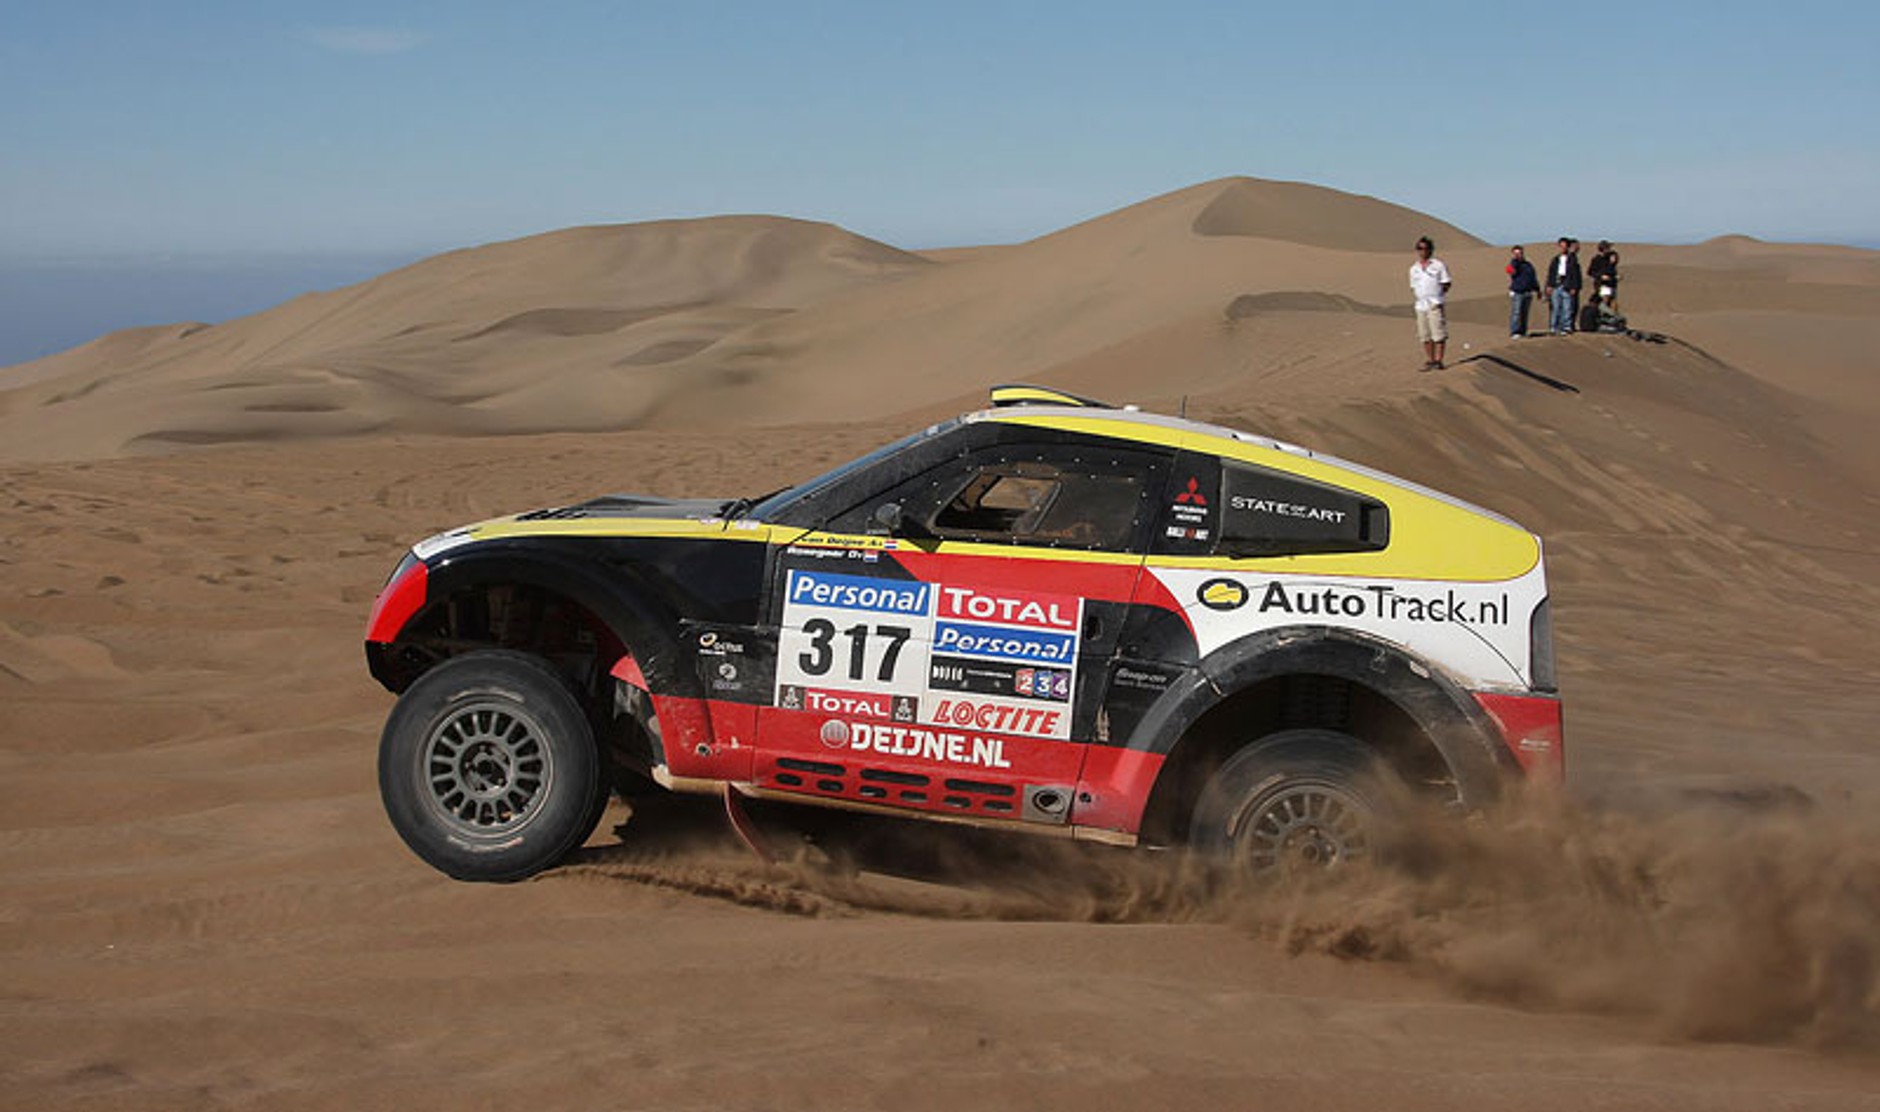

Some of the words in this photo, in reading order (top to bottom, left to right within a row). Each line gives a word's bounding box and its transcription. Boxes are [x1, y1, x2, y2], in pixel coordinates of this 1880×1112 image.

[1231, 496, 1289, 516] STATE
[1307, 508, 1346, 523] ART
[792, 575, 927, 612] Personal
[944, 587, 1073, 626] TOTAL
[1258, 580, 1508, 625] AutoTrack.nl
[799, 618, 911, 683] 317
[934, 626, 1071, 661] Personal
[807, 691, 889, 717] TOTAL
[933, 699, 1062, 735] LOCTITE
[850, 722, 1012, 769] DEIJNE.NL
